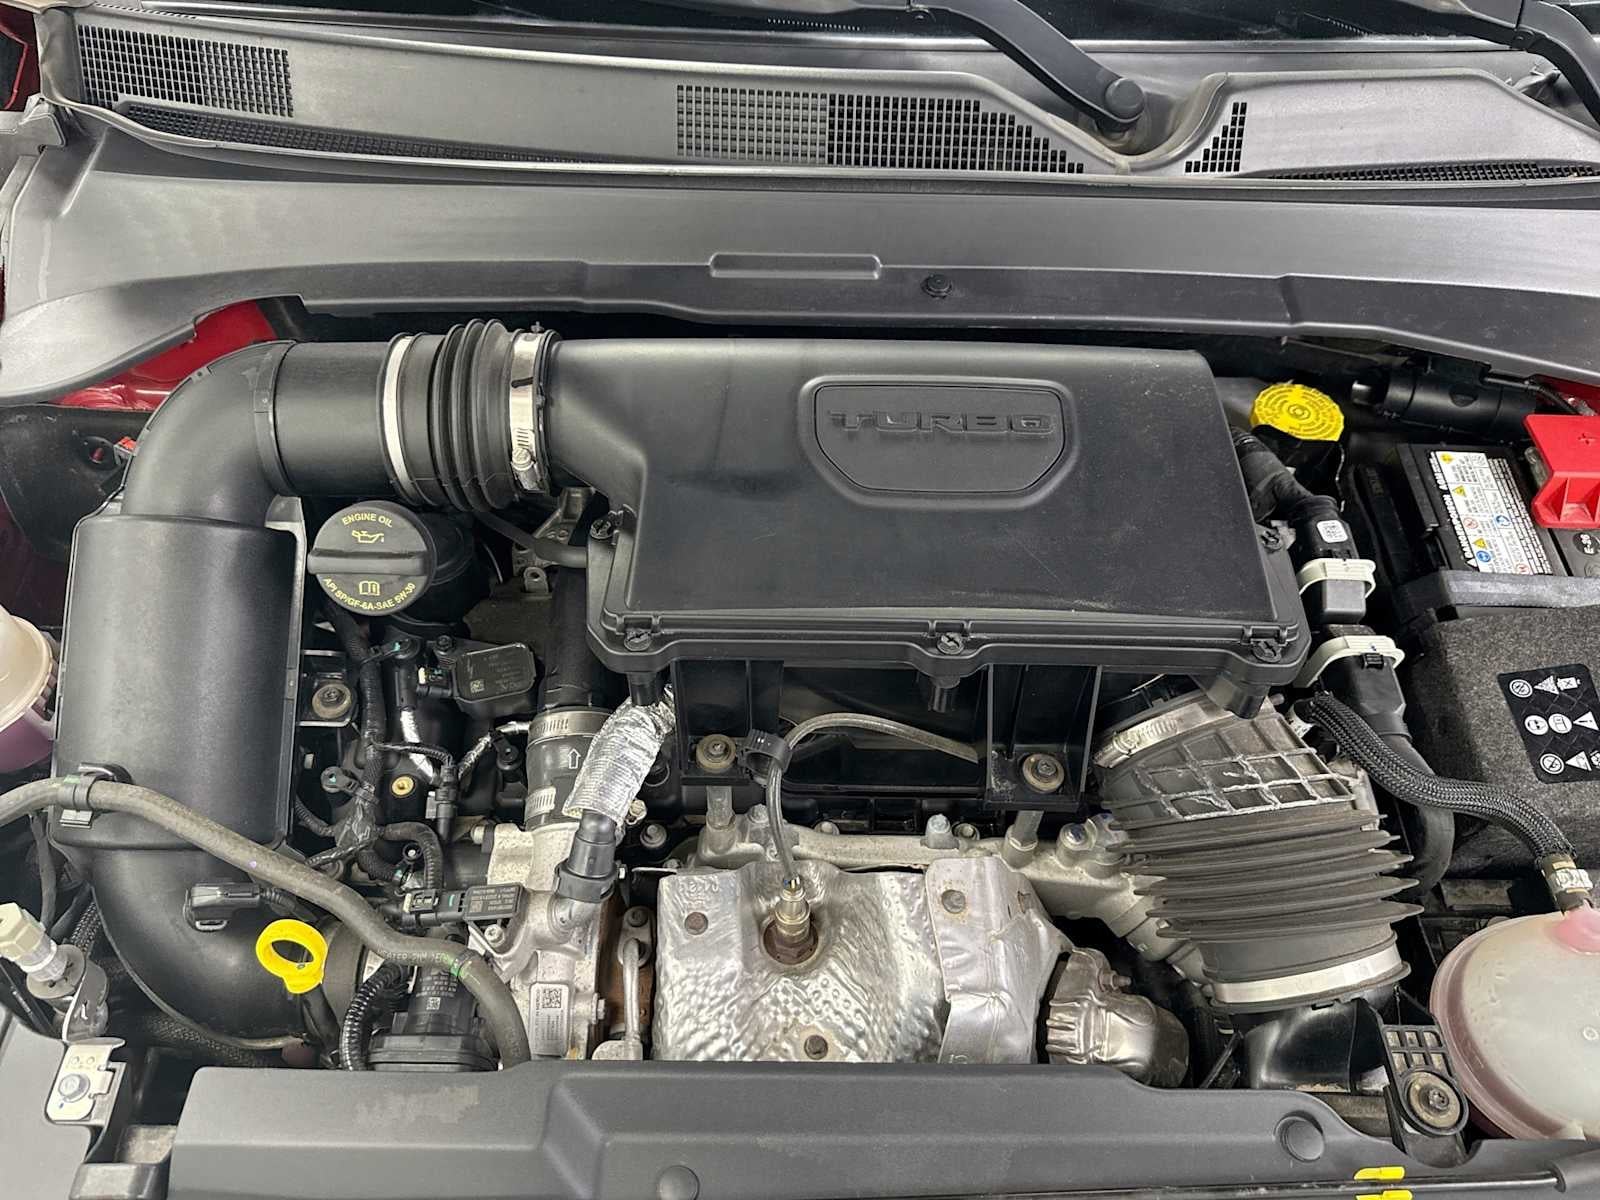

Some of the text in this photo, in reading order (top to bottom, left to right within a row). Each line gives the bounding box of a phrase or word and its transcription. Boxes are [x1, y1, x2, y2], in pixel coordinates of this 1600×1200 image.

[827, 410, 1055, 435] TURBO
[342, 513, 393, 528] ENGINE OIL
[323, 578, 338, 592] API
[394, 582, 417, 603] 5W-30
